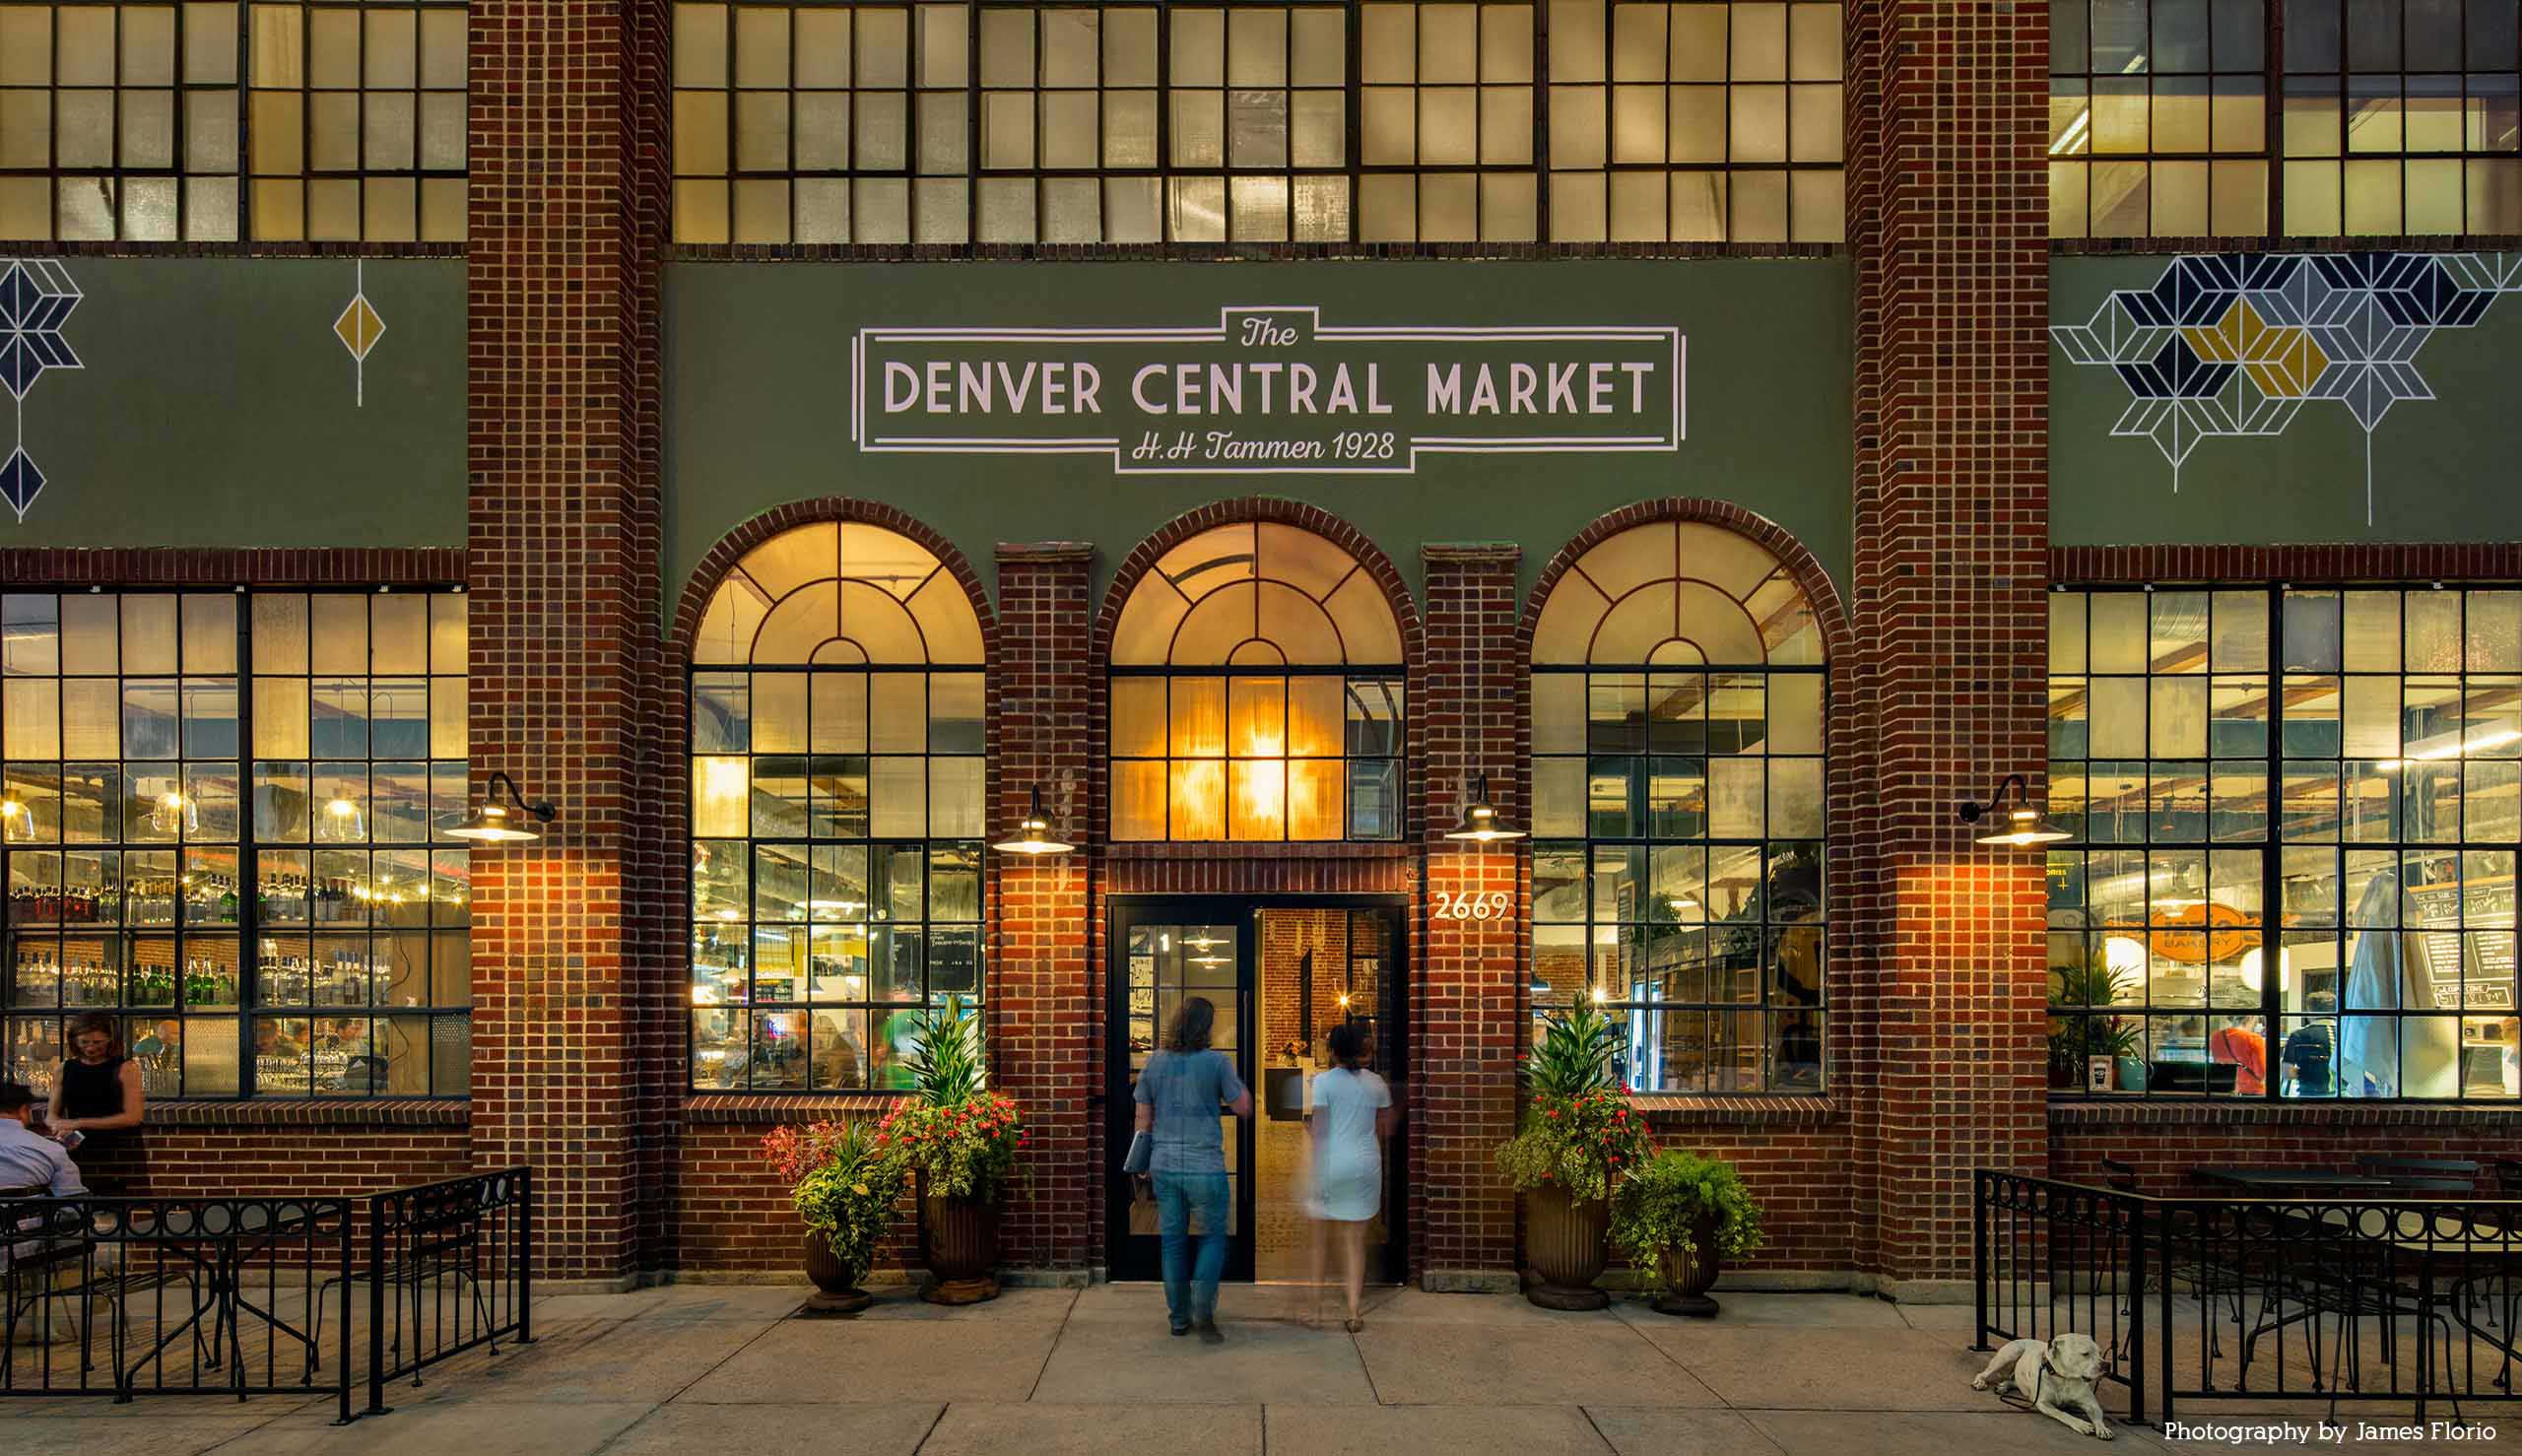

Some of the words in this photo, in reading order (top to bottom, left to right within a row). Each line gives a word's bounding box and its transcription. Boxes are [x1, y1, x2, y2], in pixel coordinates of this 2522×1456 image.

[1240, 317, 1299, 347] The
[885, 362, 1102, 414] DENVER
[1131, 362, 1394, 415] CENTRAL
[1427, 362, 1655, 415] MARKET
[1131, 430, 1198, 460] H.H
[1205, 430, 1326, 459] Tammen
[1332, 431, 1395, 460] 1928
[1434, 892, 1509, 920] 2669
